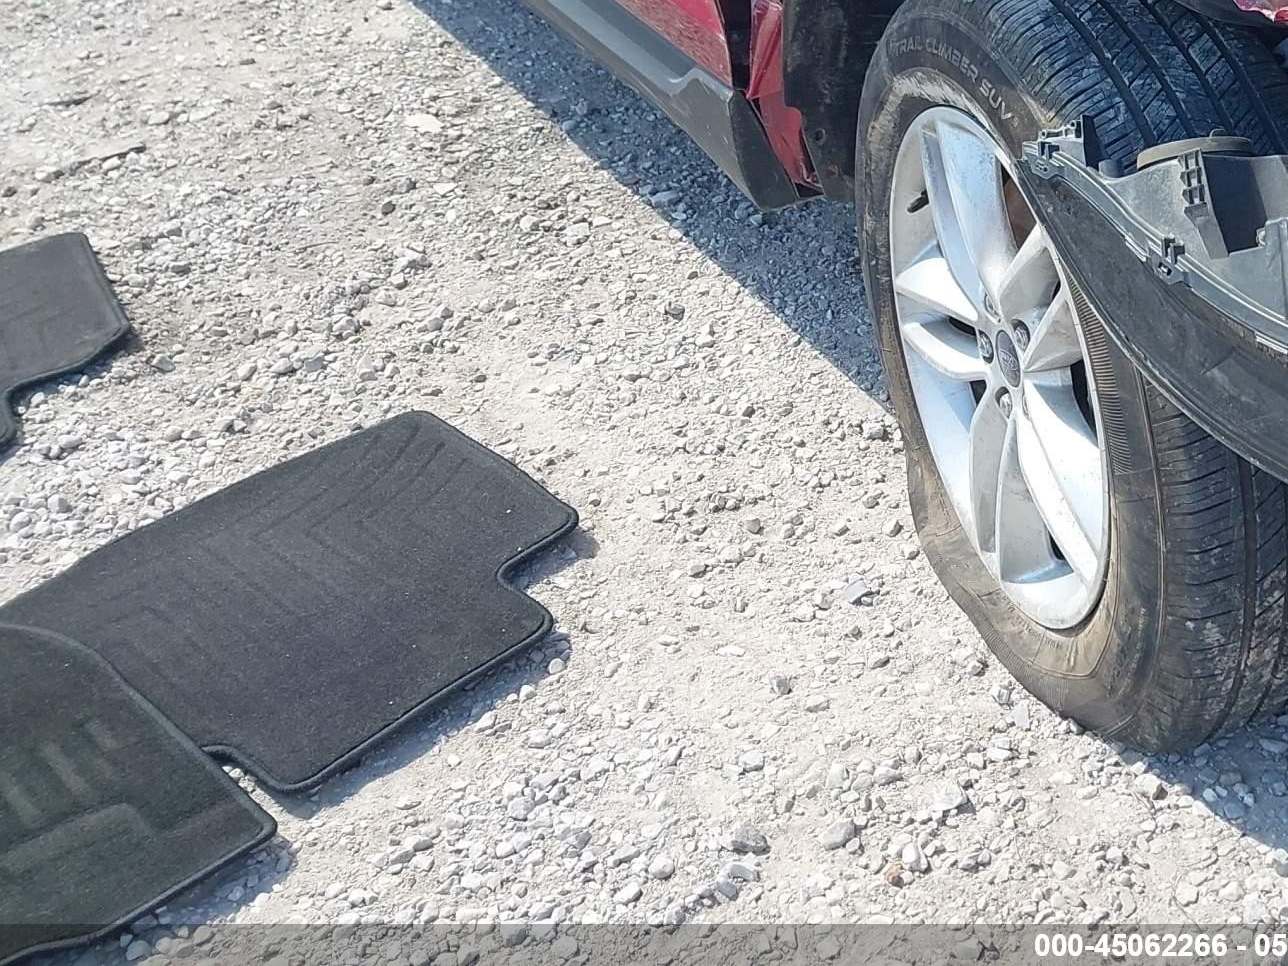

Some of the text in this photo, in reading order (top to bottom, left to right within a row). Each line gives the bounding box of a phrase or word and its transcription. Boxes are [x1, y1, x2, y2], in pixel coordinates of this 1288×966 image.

[893, 35, 1015, 120] TRAIL CLIMBER SUV
